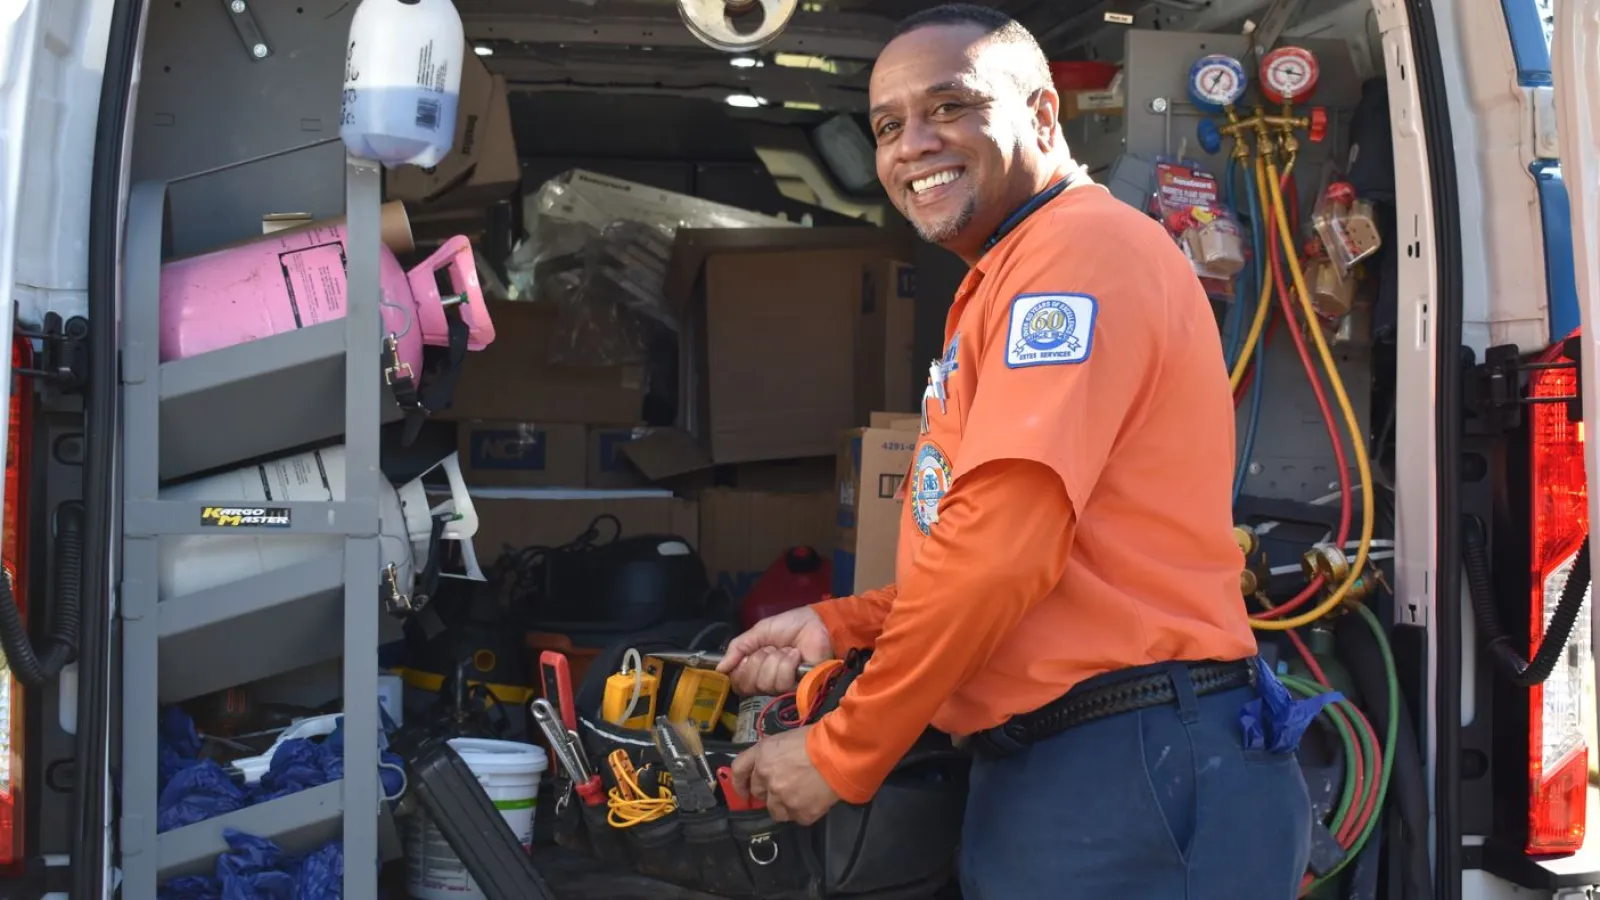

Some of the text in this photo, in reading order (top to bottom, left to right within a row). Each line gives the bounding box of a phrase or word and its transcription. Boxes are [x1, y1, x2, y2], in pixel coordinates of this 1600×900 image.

[1031, 310, 1066, 331] 60
[1040, 351, 1071, 359] SERVICES
[202, 507, 265, 518] KARGO
[218, 515, 289, 526] MASTER
